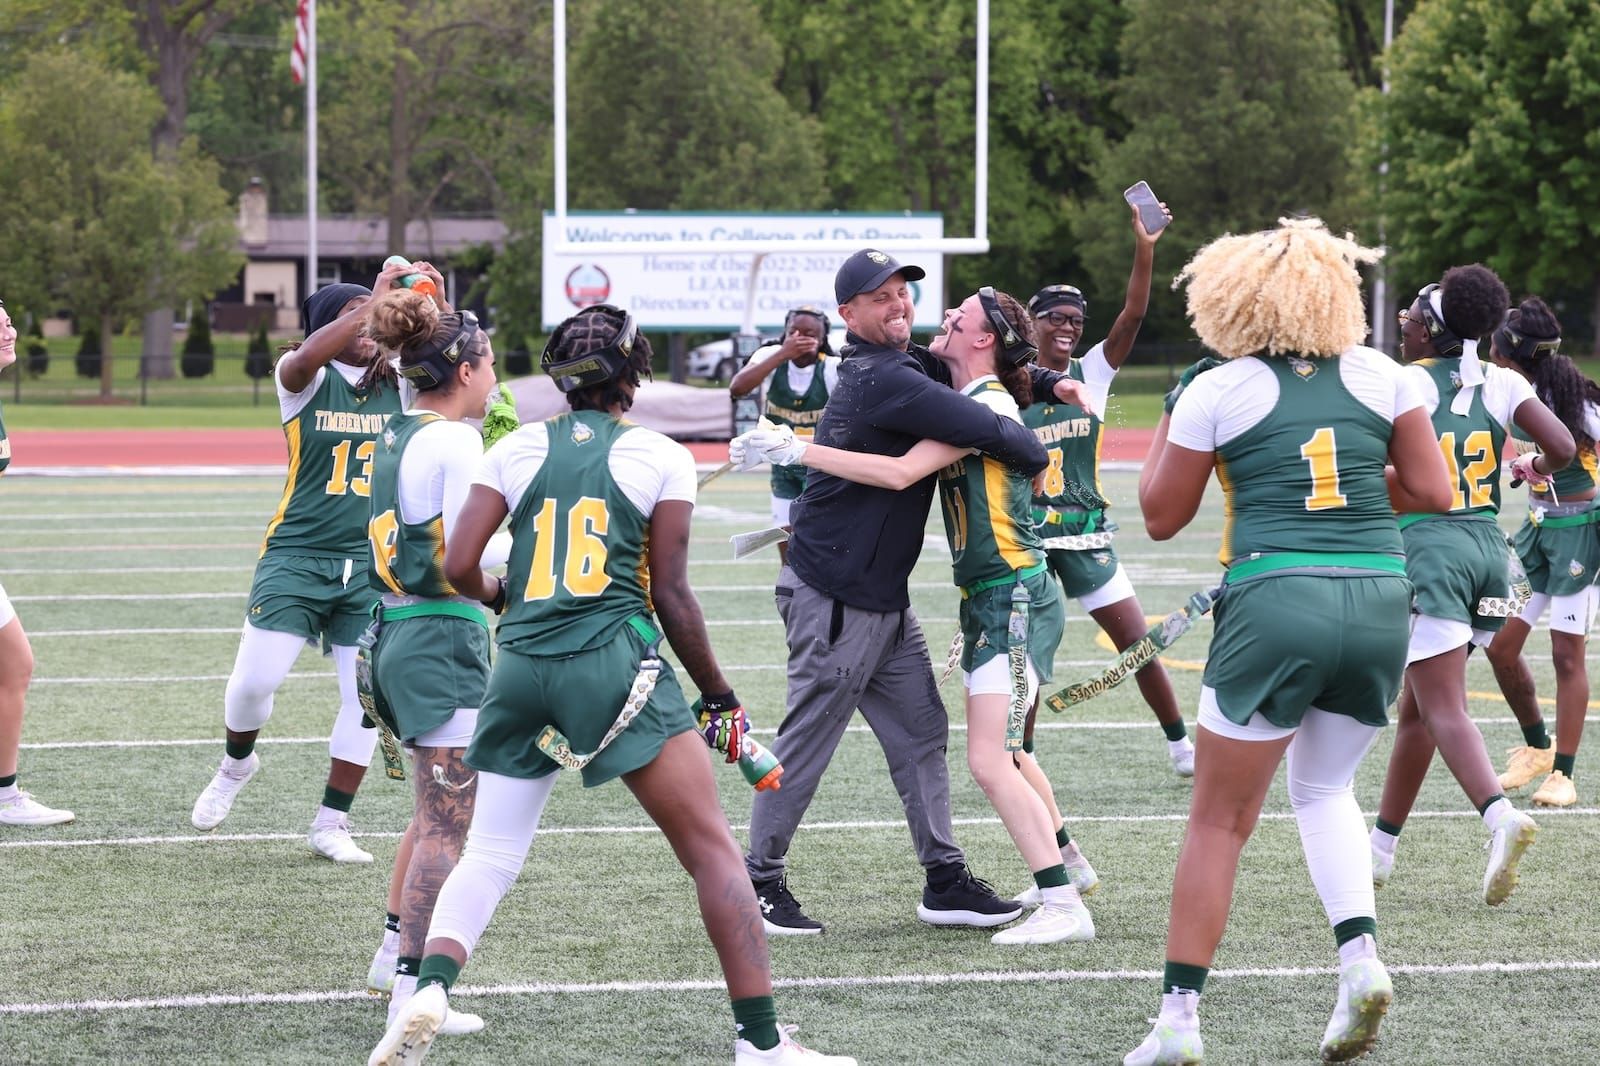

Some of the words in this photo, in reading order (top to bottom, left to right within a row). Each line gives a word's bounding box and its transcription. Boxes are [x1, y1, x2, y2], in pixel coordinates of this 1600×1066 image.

[566, 227, 672, 242] Welcome
[681, 228, 700, 241] to
[803, 227, 826, 241] of
[642, 255, 695, 271] Home
[702, 254, 720, 271] of
[721, 255, 748, 271] the
[718, 295, 745, 311] Cu
[325, 440, 377, 497] 13
[1301, 427, 1347, 511] 1
[1437, 431, 1499, 512] 12
[524, 497, 613, 602] 16
[1011, 646, 1027, 732] TIMBERWOLVES
[1068, 636, 1158, 703] TIMBERWOLVES
